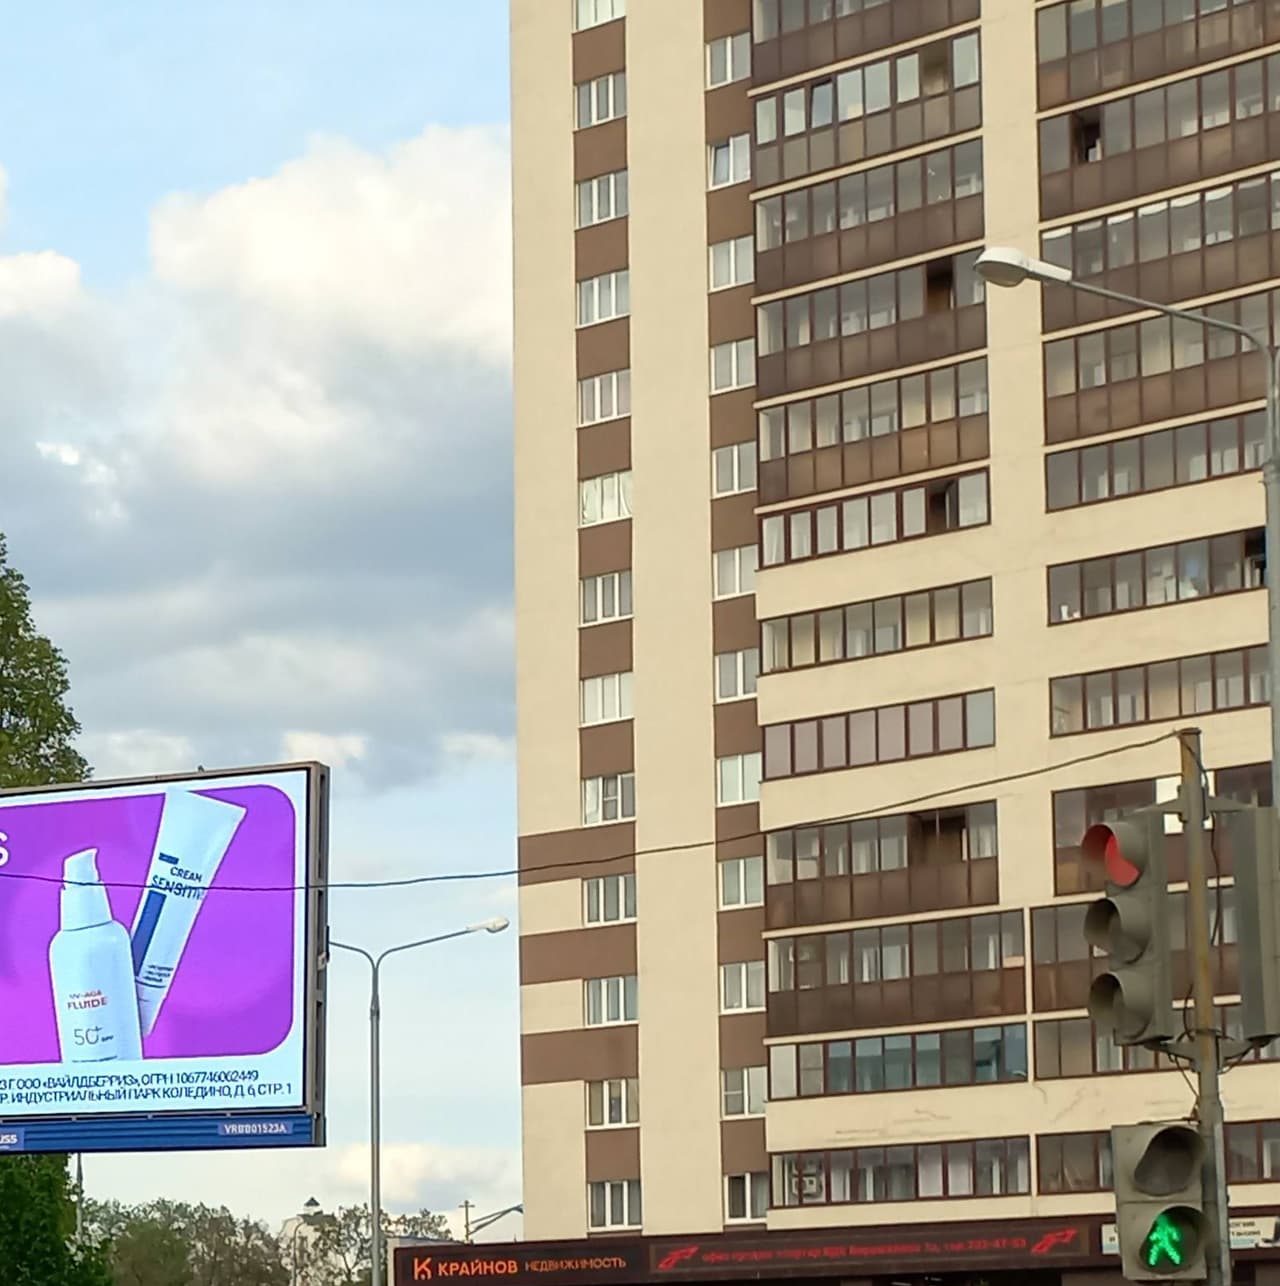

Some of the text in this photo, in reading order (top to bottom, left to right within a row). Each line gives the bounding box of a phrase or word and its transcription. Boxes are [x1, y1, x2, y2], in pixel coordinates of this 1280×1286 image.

[17, 1077, 40, 1090] ООО
[141, 1073, 173, 1085] ОГРН
[287, 1083, 292, 1094] 1
[438, 1258, 518, 1277] КРАЙНОВ
[525, 1257, 626, 1272] НЕДВИЖИМОСТЬ
